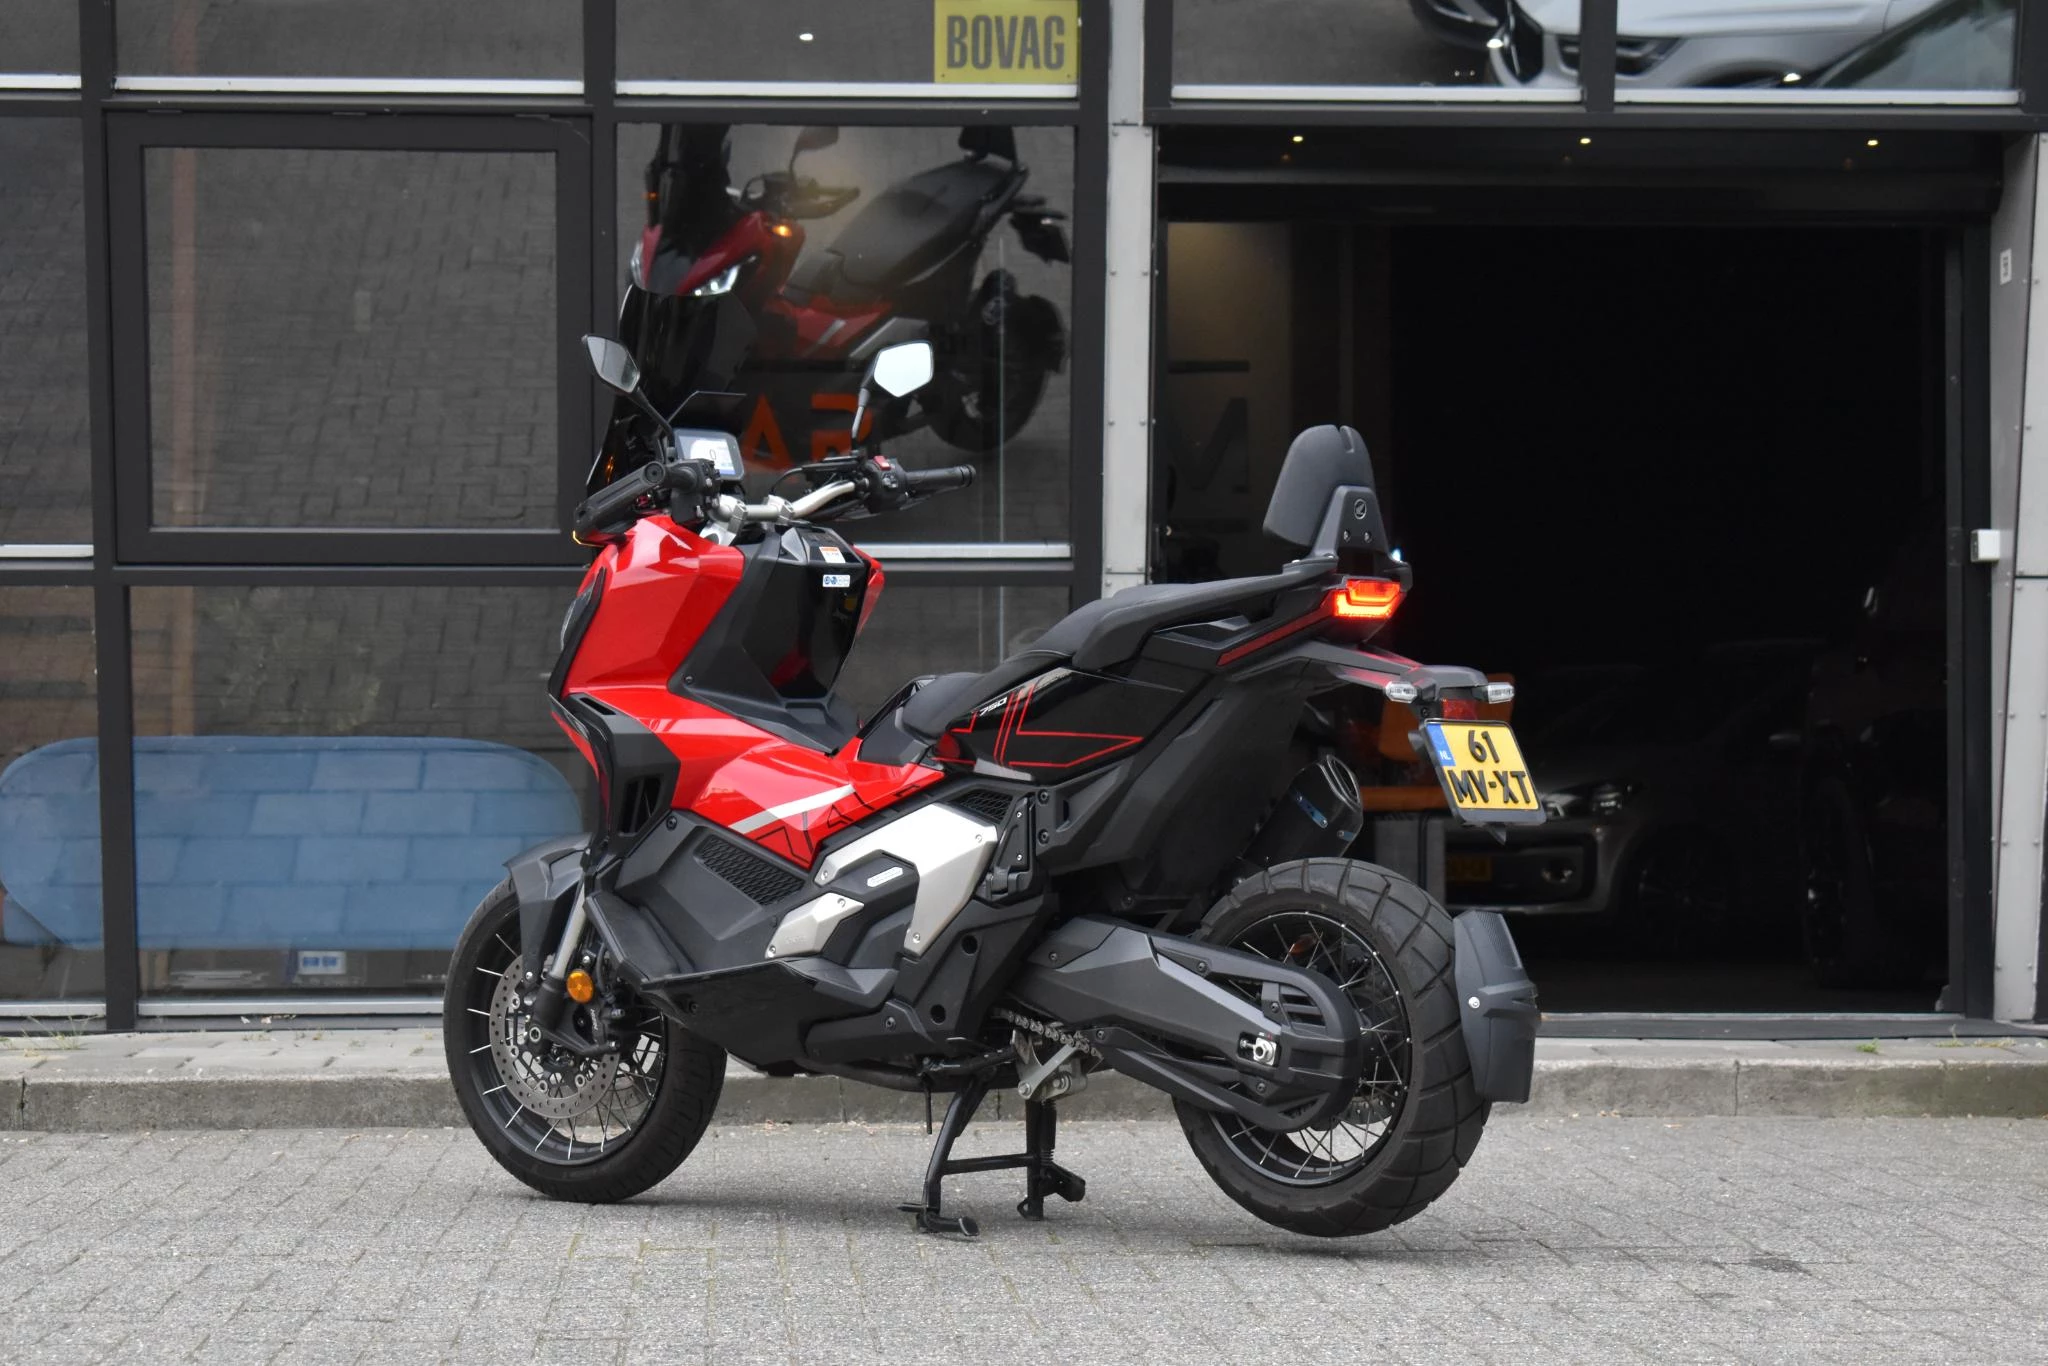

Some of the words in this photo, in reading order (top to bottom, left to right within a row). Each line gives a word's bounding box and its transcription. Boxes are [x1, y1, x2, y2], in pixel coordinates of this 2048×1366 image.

[947, 15, 1065, 70] BOVAG
[979, 696, 1008, 717] 750
[1439, 750, 1452, 760] NL
[1468, 730, 1500, 763] 61
[1447, 769, 1531, 804] MV-XT
